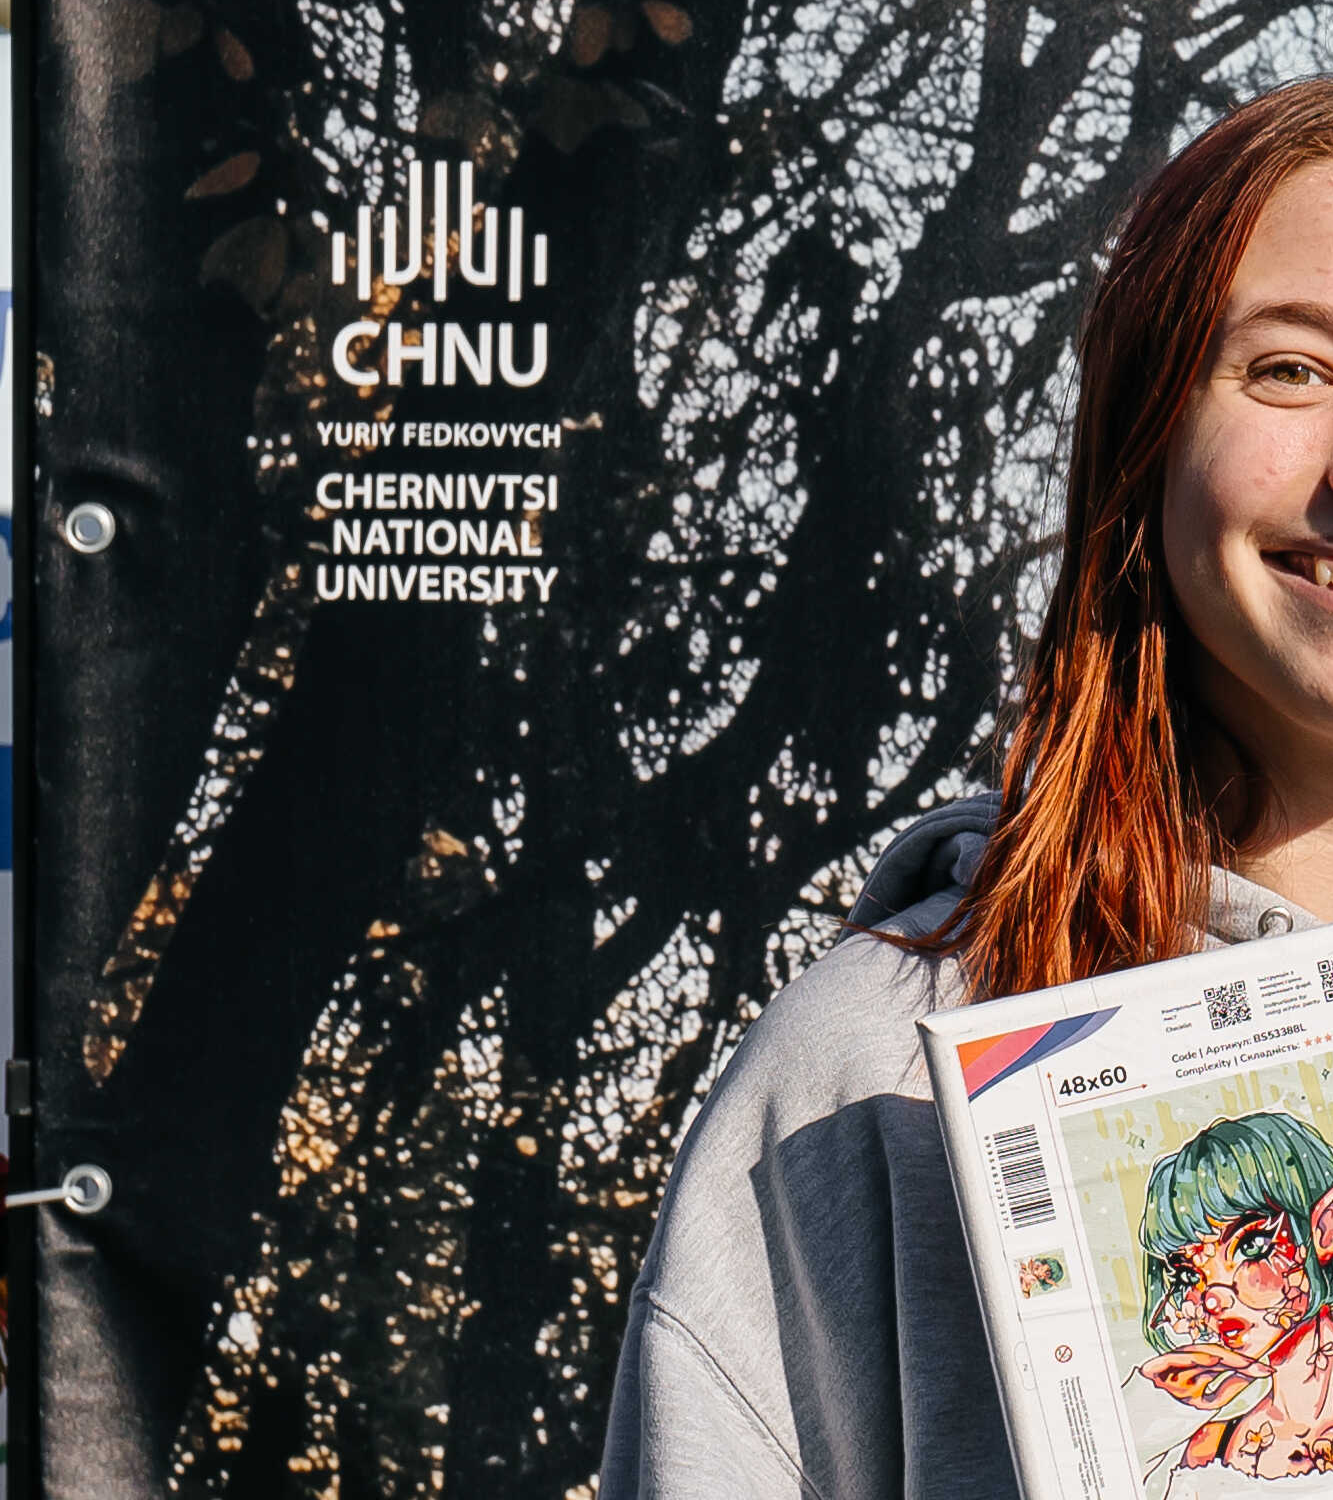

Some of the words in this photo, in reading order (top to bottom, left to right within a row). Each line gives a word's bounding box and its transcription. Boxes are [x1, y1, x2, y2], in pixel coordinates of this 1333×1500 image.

[332, 321, 548, 387] CHNU
[317, 422, 396, 447] YURIY
[403, 422, 561, 448] FEDKOVYCH
[316, 473, 559, 511] CHERNIVTSI
[332, 520, 543, 556] NATIONAL
[316, 565, 559, 602] UNIVERSITY
[1171, 1049, 1198, 1064] Code
[1205, 1038, 1252, 1061] Артикул:
[1175, 1056, 1232, 1079] Complexity
[1239, 1040, 1301, 1064] Складність:
[1058, 1065, 1129, 1098] 48x60
